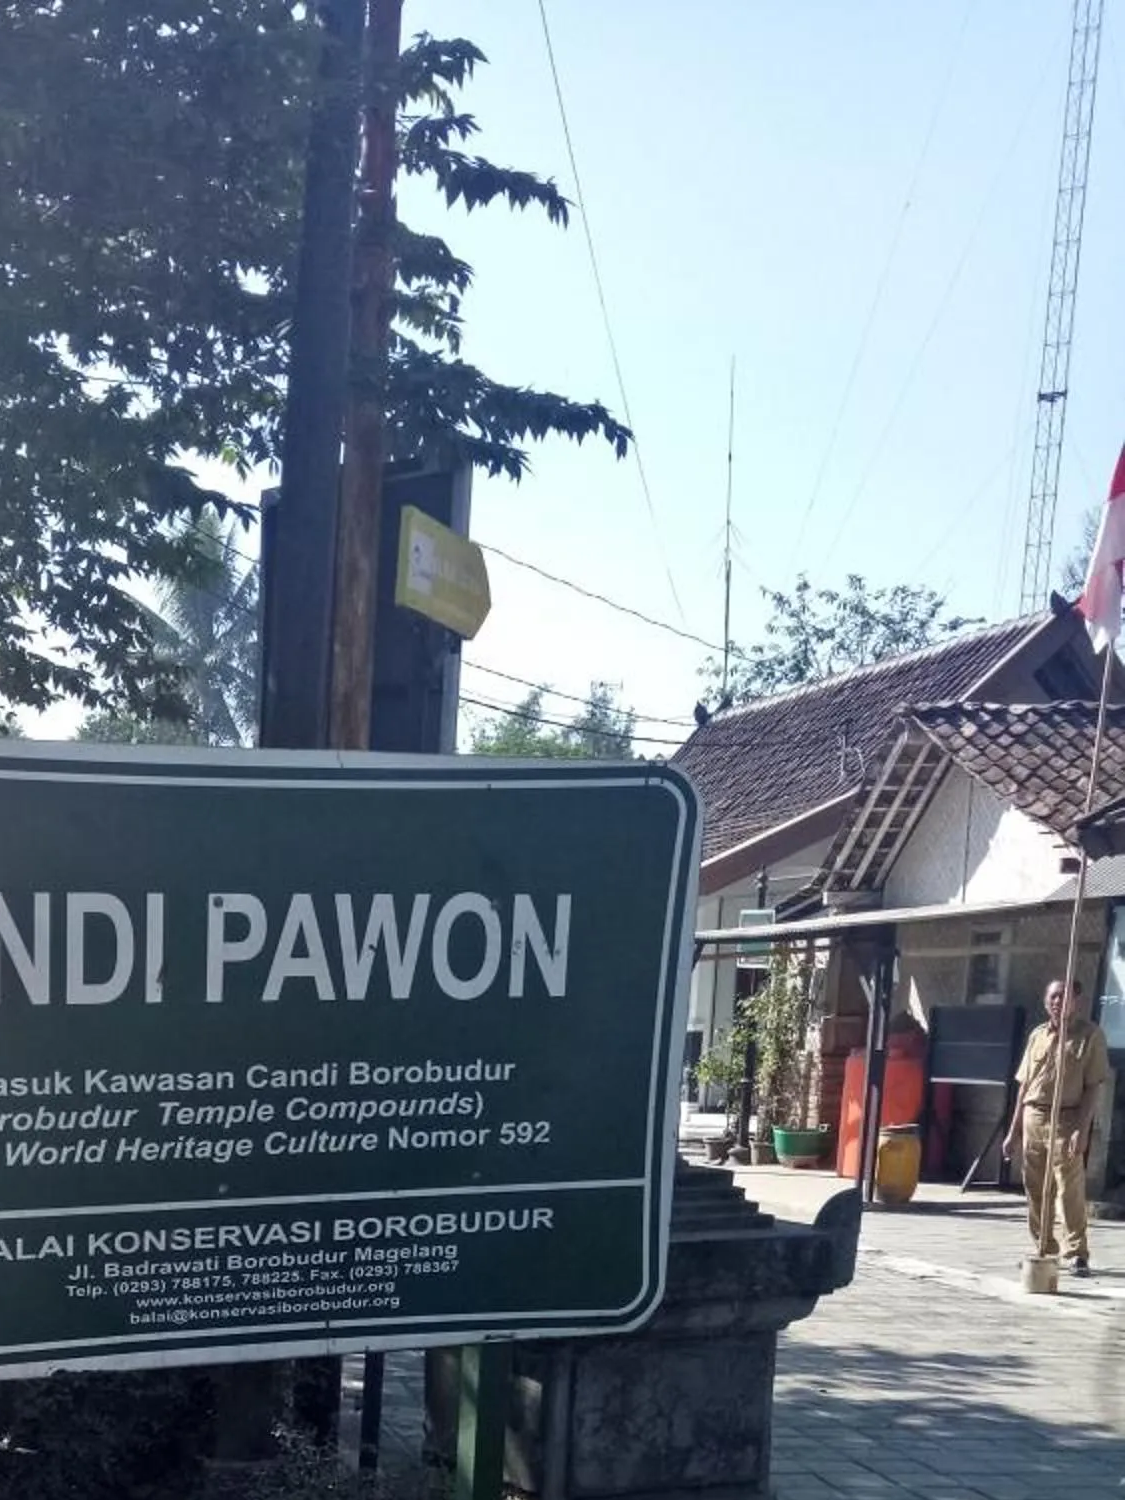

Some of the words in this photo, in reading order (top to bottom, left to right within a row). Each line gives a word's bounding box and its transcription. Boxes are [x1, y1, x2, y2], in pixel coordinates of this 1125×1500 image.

[206, 891, 572, 1001] PAWON
[84, 1068, 235, 1095] Kawasan
[246, 1063, 339, 1088] Candi
[349, 1059, 516, 1086] Borobudur
[158, 1099, 275, 1129] Temple
[286, 1091, 484, 1125] Compounds)
[5, 1138, 107, 1167] World
[115, 1135, 254, 1163] Heritage
[264, 1129, 378, 1155] Culture
[387, 1125, 491, 1151] Nomor
[498, 1121, 551, 1146] 592
[87, 1220, 322, 1258] KONSERVASI
[332, 1207, 555, 1242] BOROBUDUR
[65, 1284, 108, 1299] Telp.
[112, 1279, 167, 1297] (0293)
[310, 1269, 344, 1282] Fax.
[349, 1264, 399, 1281] (0293)
[403, 1259, 460, 1275] 788367
[68, 1264, 95, 1281] Jl.
[104, 1255, 220, 1279] Badrawati
[227, 1250, 348, 1271] Borobudur
[354, 1243, 459, 1263] Magelang
[129, 1296, 401, 1325] balai@konservasiborobudur.org
[136, 1281, 396, 1309] www.konservasiborobudur.org
